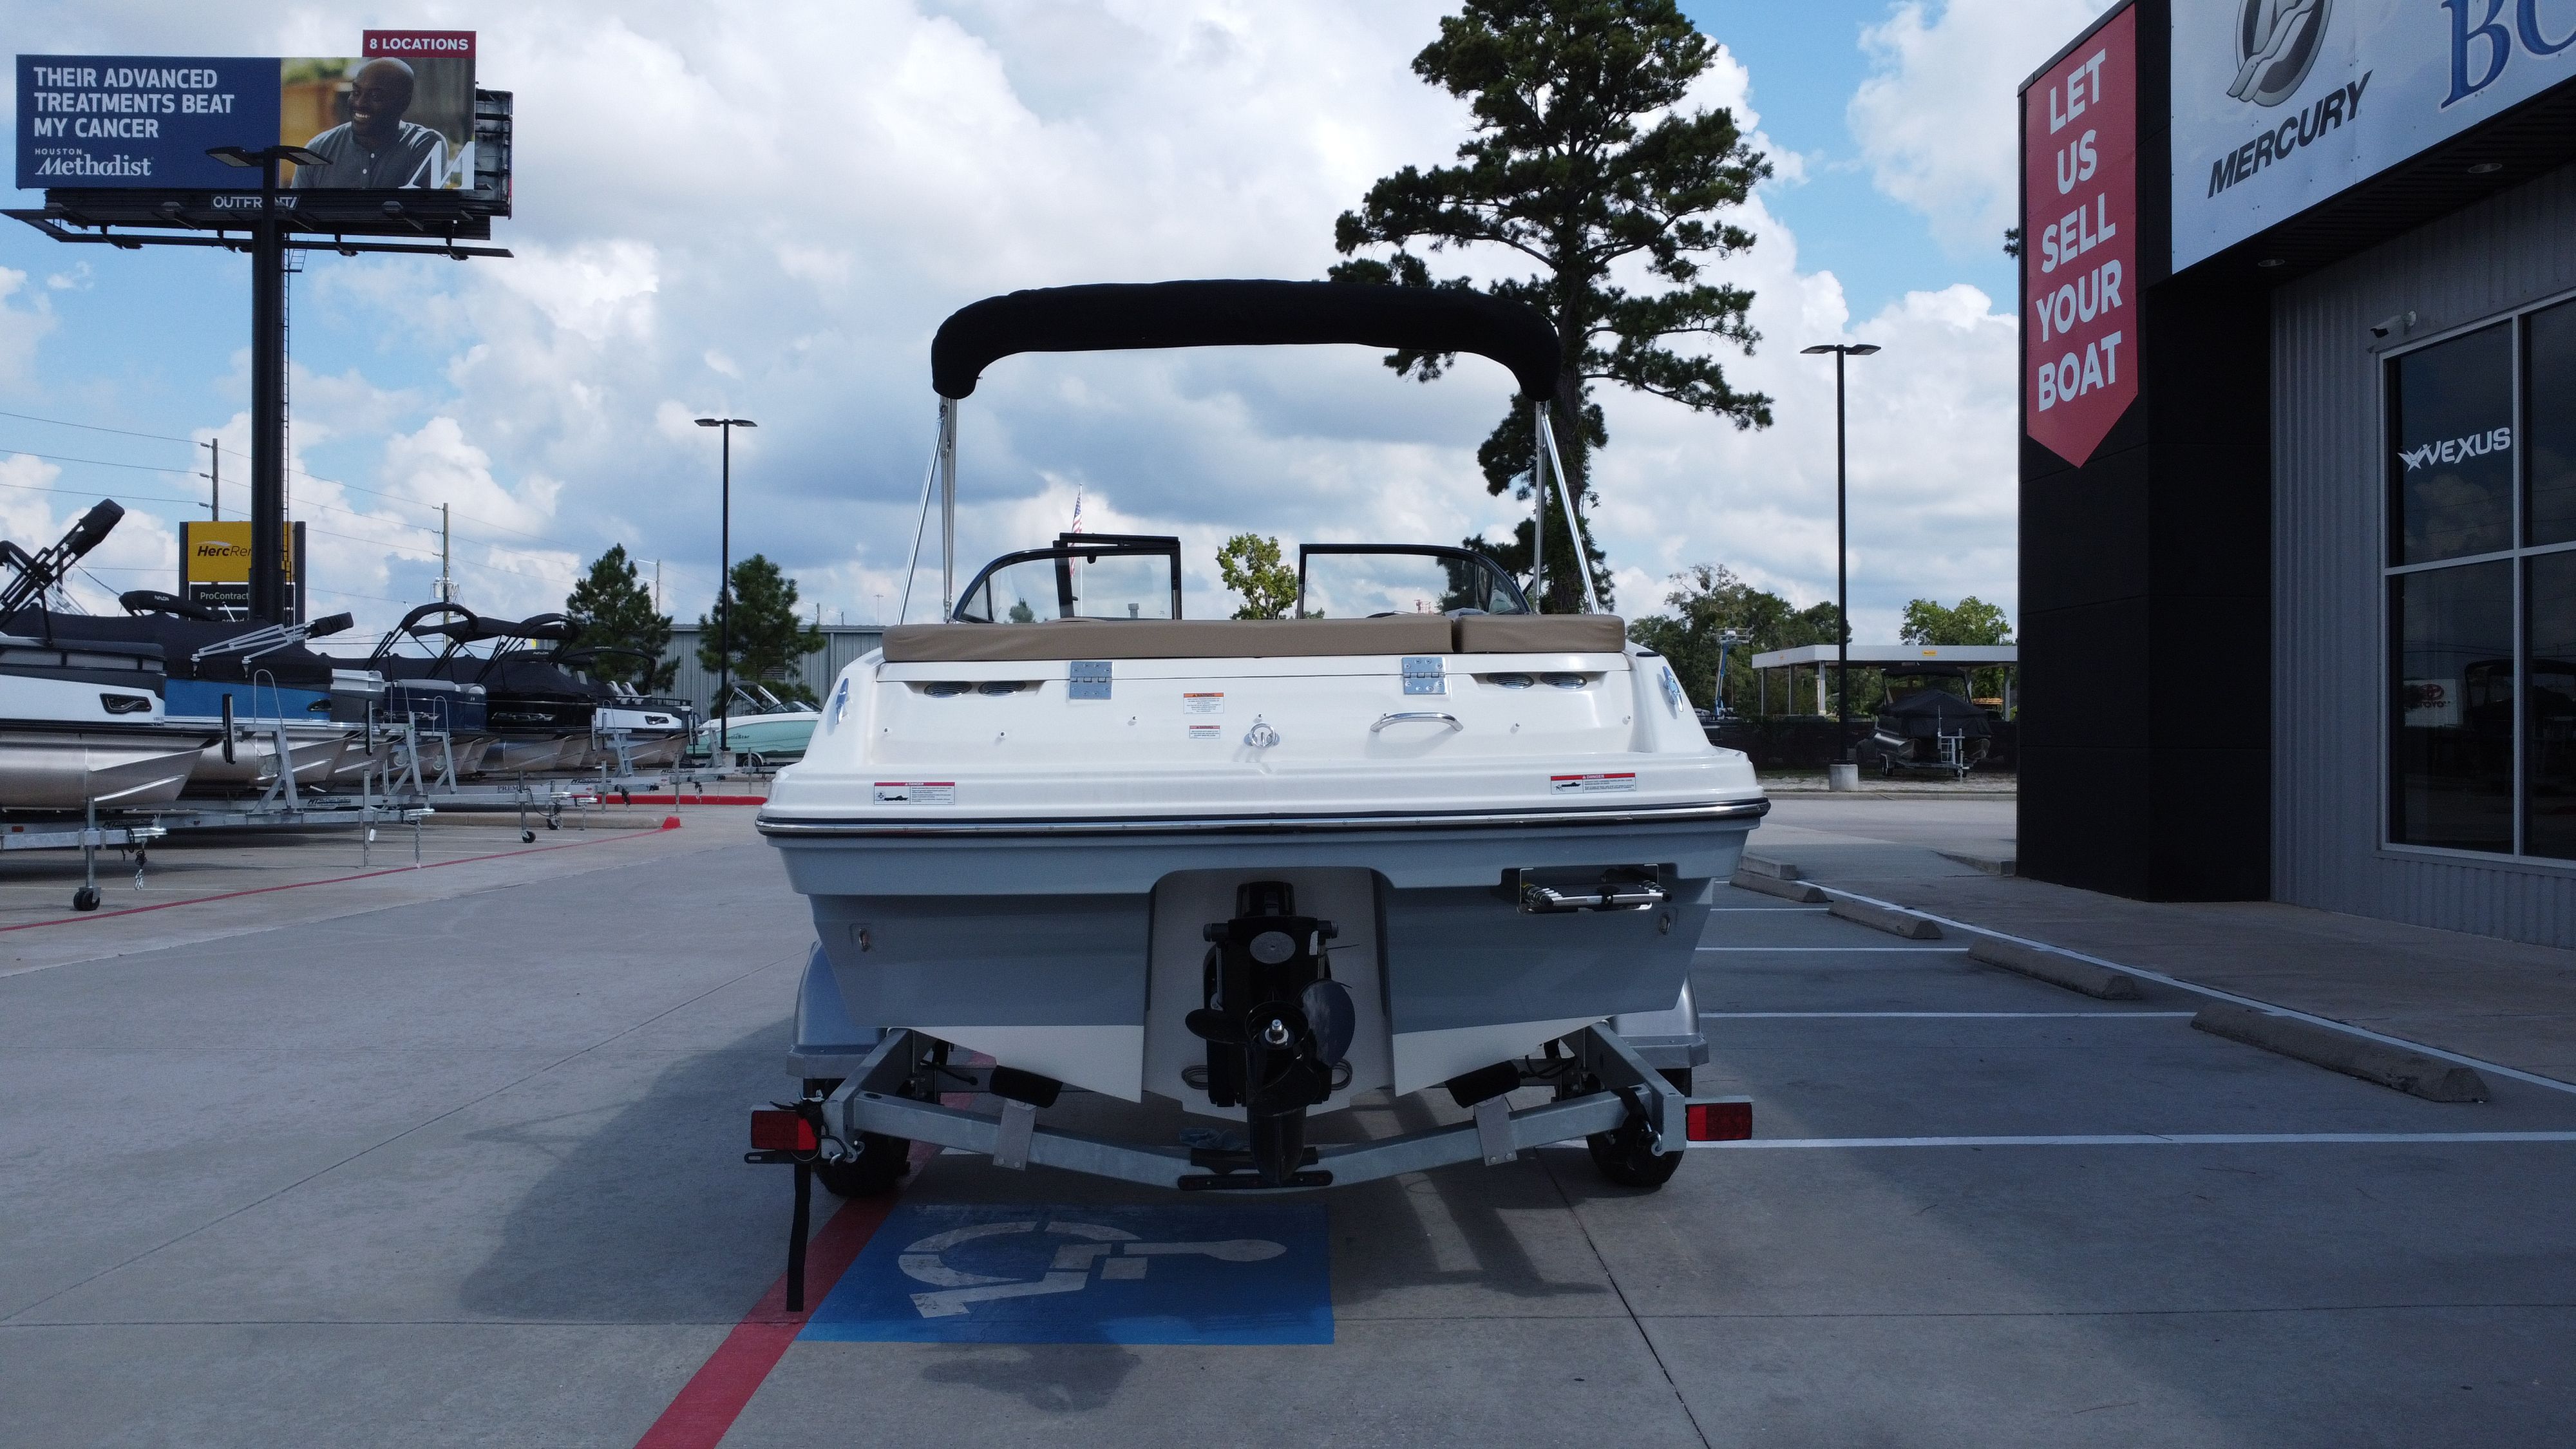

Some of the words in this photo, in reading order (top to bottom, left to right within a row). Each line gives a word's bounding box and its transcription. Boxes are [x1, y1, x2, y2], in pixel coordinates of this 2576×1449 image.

[369, 37, 377, 50] 8
[382, 37, 469, 50] LOCATIONS
[33, 67, 97, 87] THEIR
[104, 68, 218, 88] ADVANCED
[33, 92, 175, 113] TREATMENTS
[182, 94, 235, 113] BEAT
[2050, 48, 2106, 135] LET
[34, 117, 68, 137] MY
[75, 118, 159, 138] CANCER
[2207, 68, 2374, 199] MERCURY
[34, 153, 152, 176] Methodist
[2057, 129, 2098, 195] US
[2041, 192, 2116, 274] SELL
[2035, 258, 2123, 343] YOUR
[2038, 329, 2121, 413] BOAT
[2421, 426, 2511, 466] VEXUS
